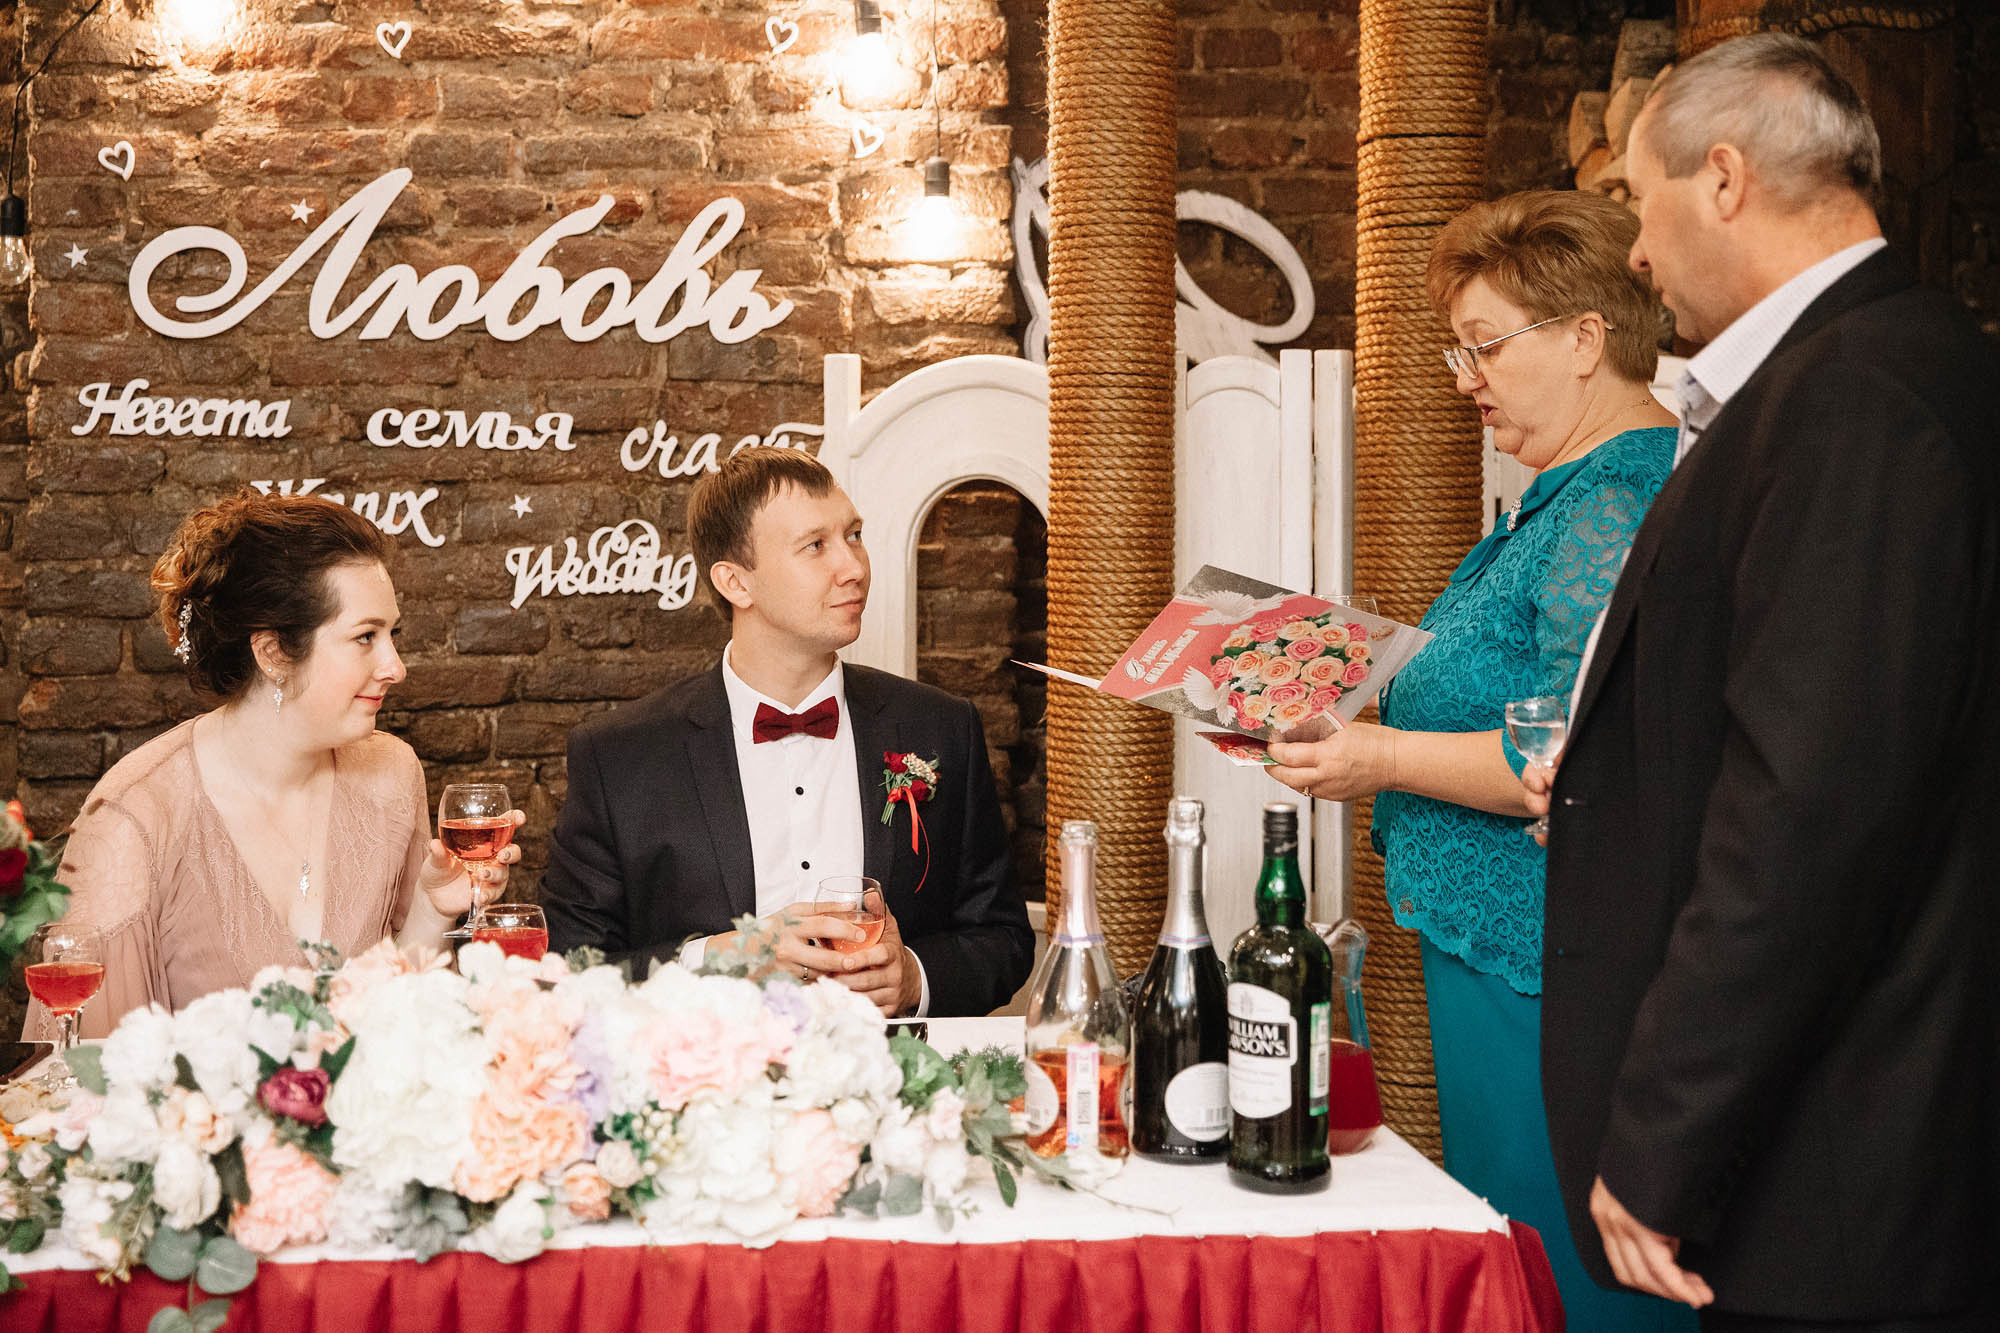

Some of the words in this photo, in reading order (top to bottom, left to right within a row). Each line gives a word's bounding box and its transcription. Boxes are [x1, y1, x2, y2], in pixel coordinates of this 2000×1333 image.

[128, 167, 795, 344] Любовь
[71, 378, 293, 438] Невеста
[366, 408, 577, 451] семья
[250, 478, 446, 547] них
[505, 519, 697, 611] Wedding
